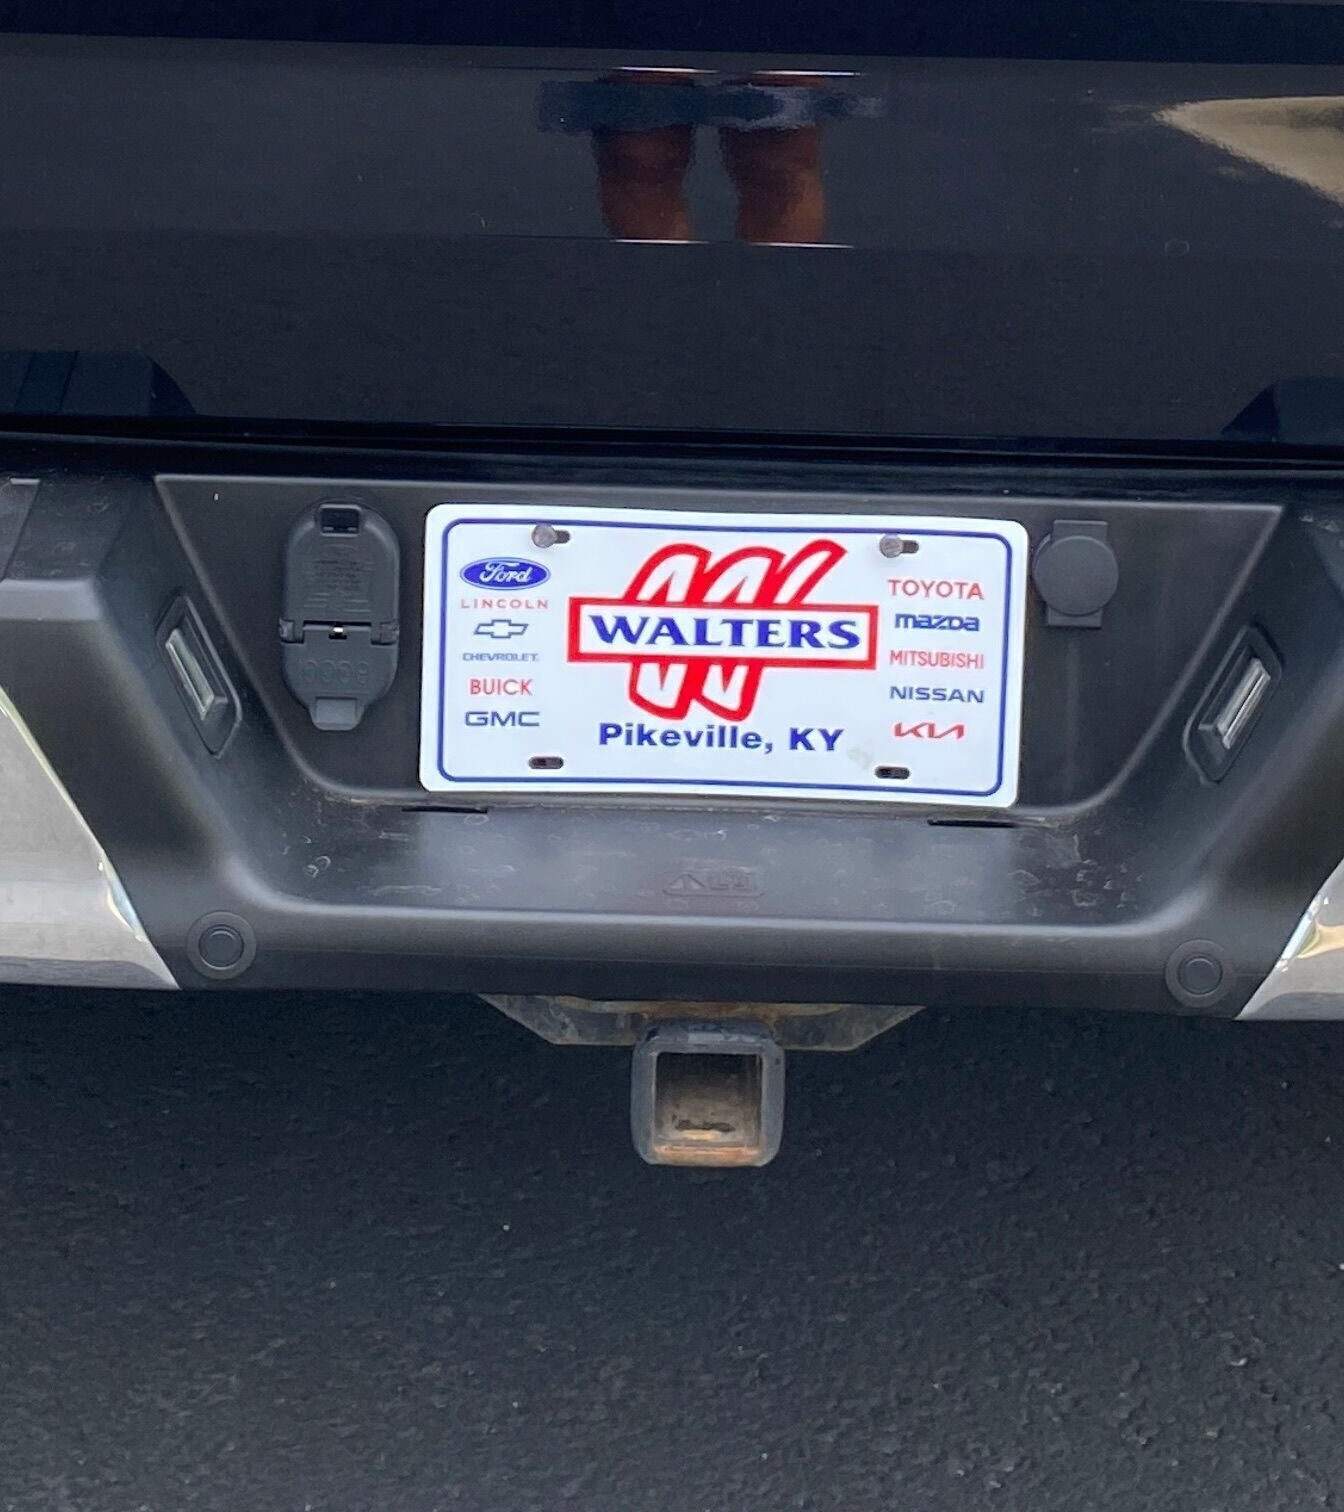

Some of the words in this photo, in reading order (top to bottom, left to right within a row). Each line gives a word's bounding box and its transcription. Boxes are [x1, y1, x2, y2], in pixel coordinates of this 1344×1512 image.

[888, 579, 985, 600] TOYOTA
[460, 599, 549, 609] LINCOLN
[588, 613, 861, 650] WALTERS
[462, 652, 538, 662] CHEVROLET
[889, 650, 984, 669] MITSUBISHI
[469, 678, 533, 696] BUICK
[890, 686, 985, 704] NISSAN
[465, 711, 541, 727] GMC
[598, 722, 774, 755] Pikeville,
[788, 727, 845, 752] KY
